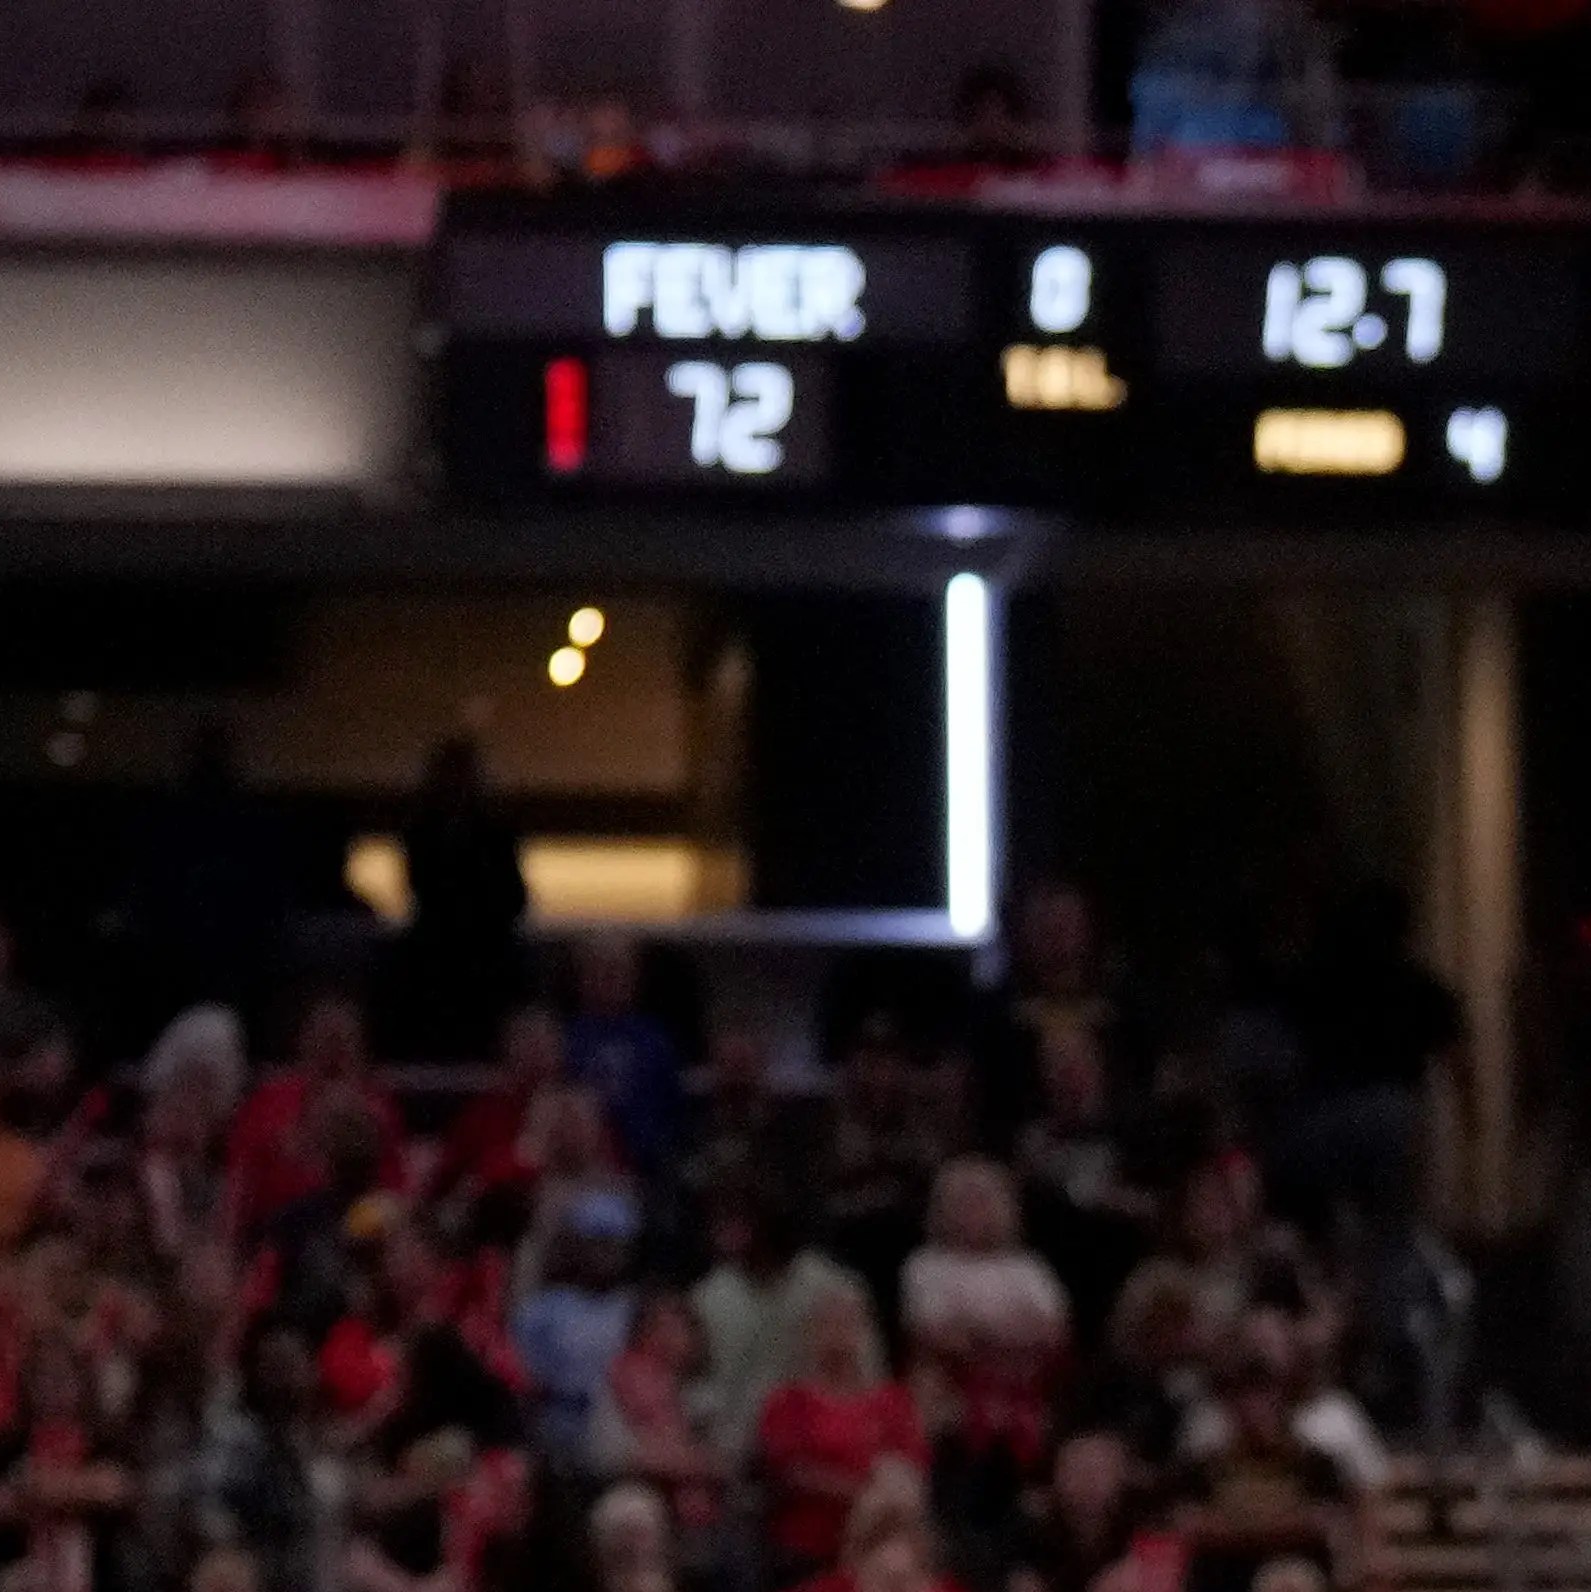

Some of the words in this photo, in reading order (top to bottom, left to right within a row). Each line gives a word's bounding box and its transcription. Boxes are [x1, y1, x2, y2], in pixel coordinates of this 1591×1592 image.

[603, 241, 866, 342] FEVER
[1262, 255, 1447, 370] 12.7
[666, 361, 795, 474] 72
